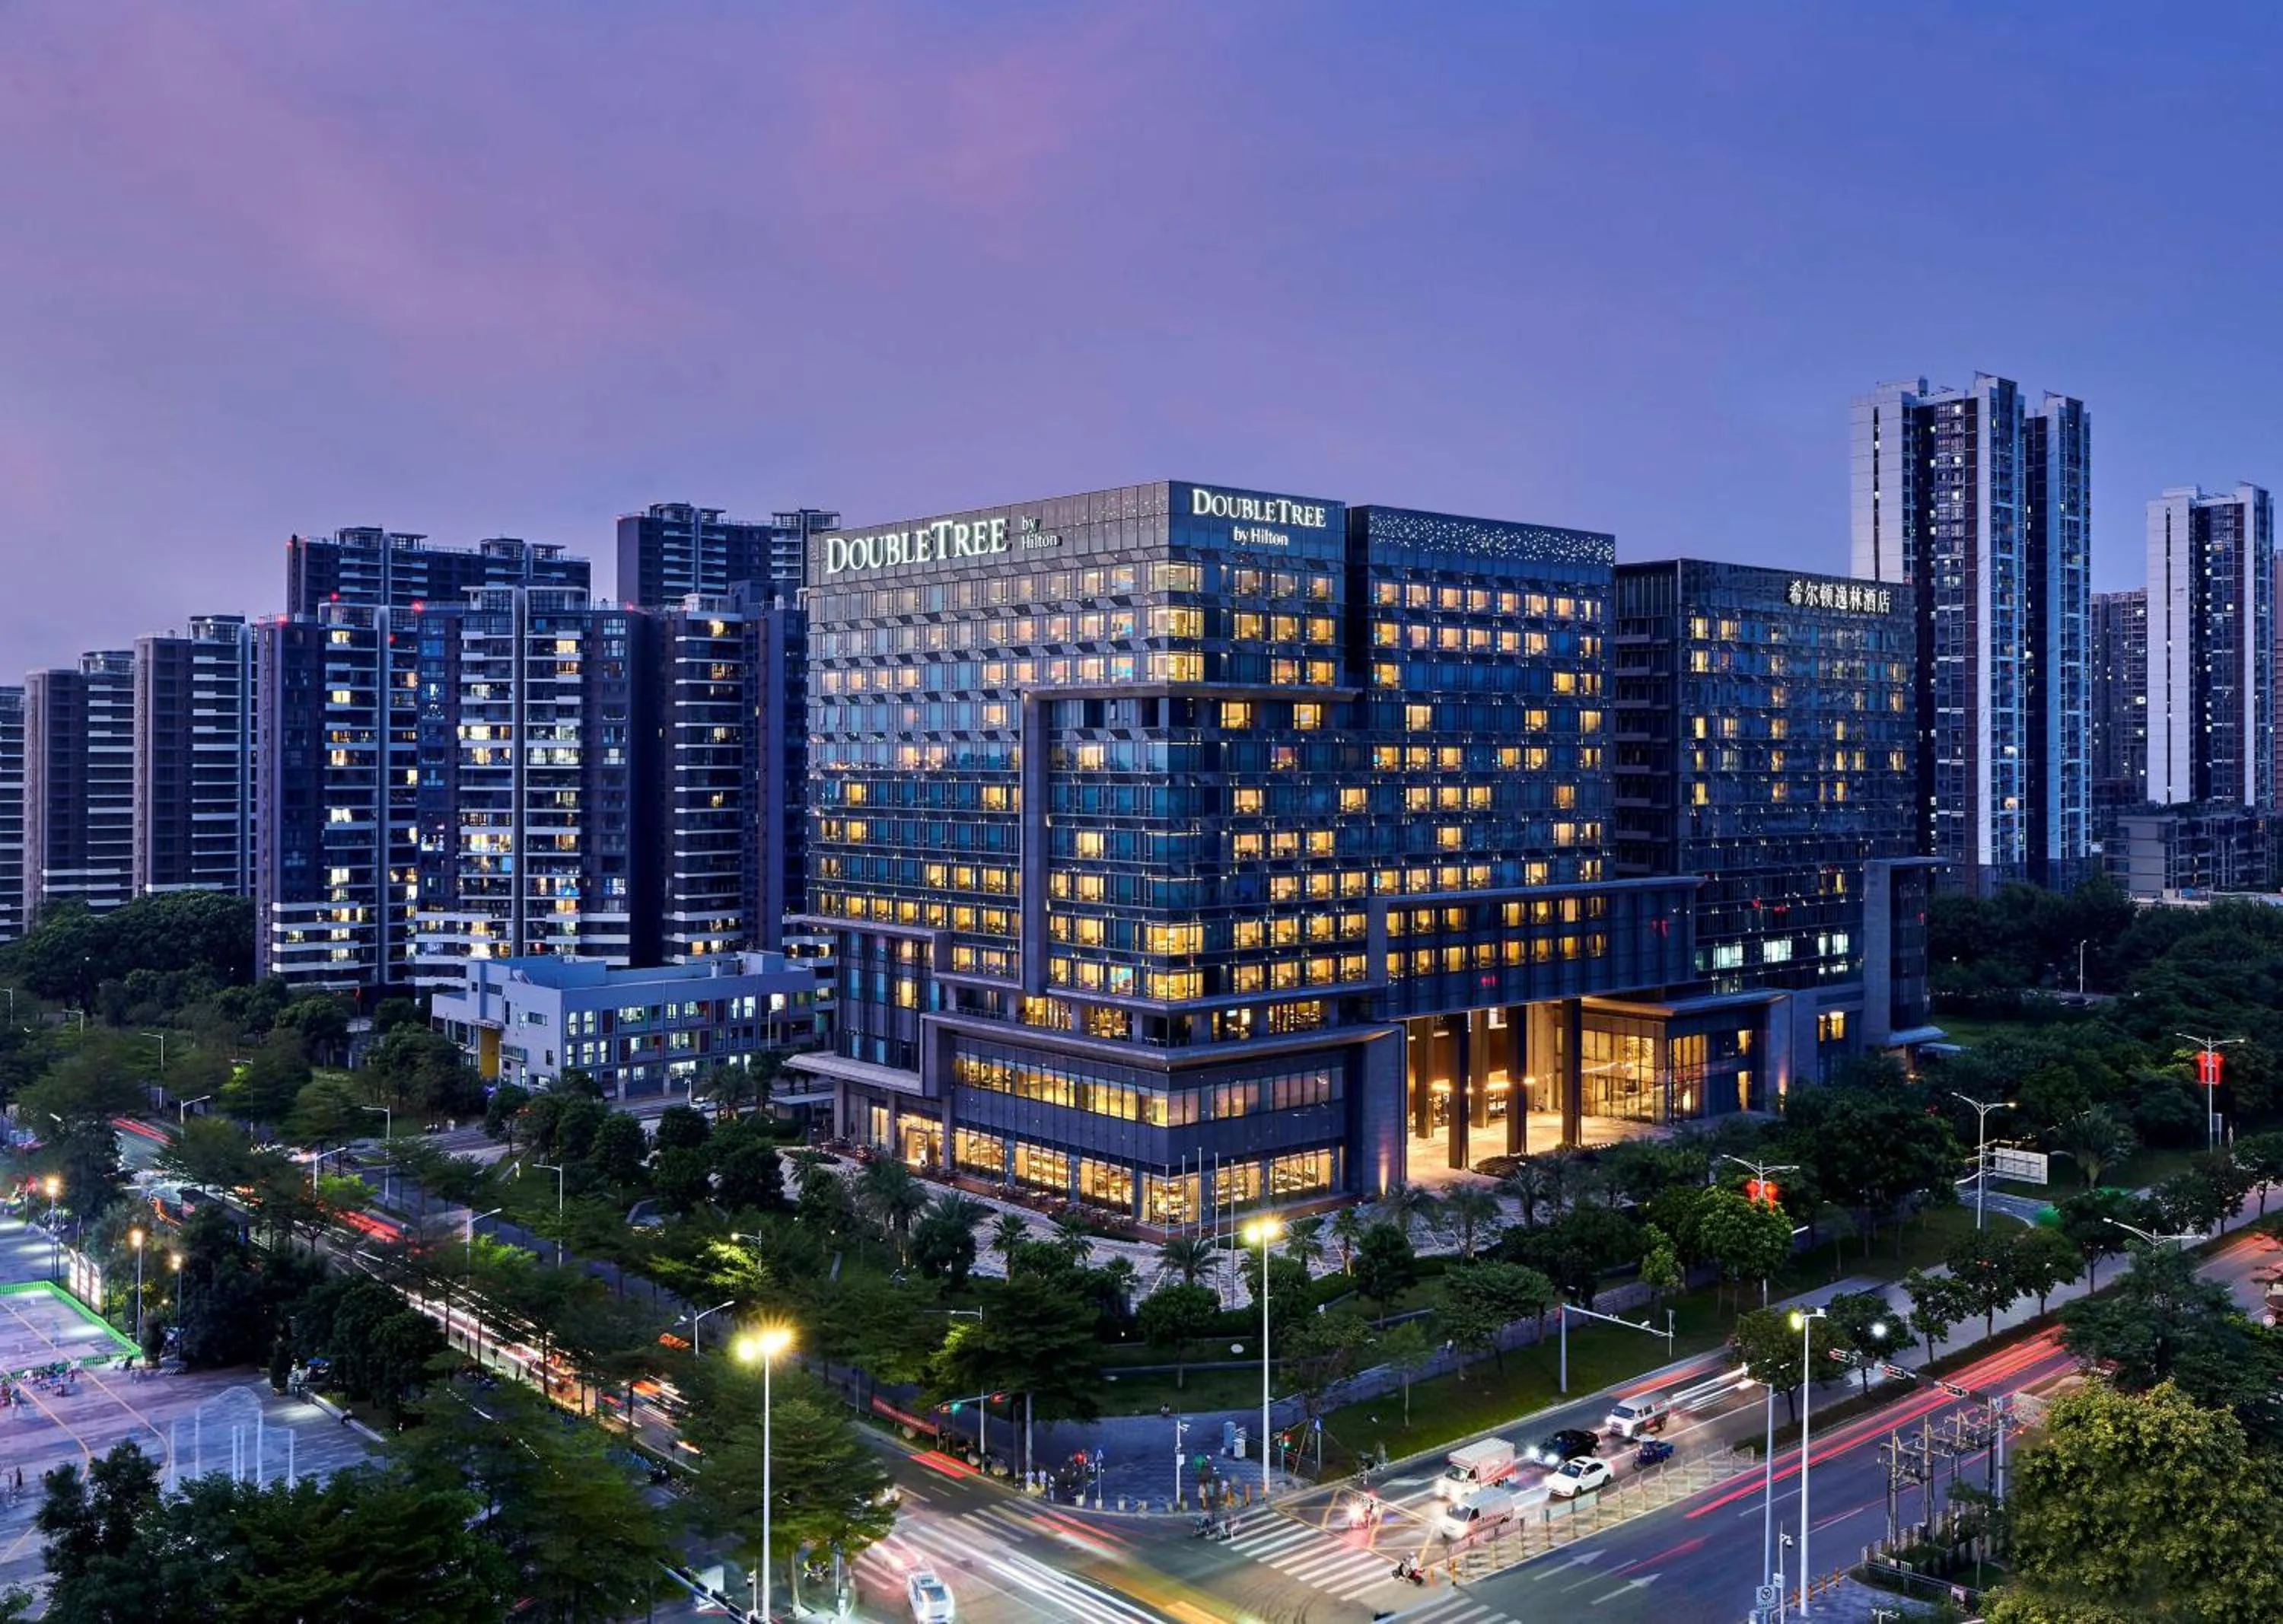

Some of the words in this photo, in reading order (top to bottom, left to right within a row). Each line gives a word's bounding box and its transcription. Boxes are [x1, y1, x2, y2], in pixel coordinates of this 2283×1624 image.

[1022, 515, 1036, 533] by
[1022, 533, 1058, 549] Hilton
[1234, 526, 1249, 546] by
[1250, 527, 1288, 546] Hilton
[1789, 580, 1890, 613] 希尔顿逸林酒店
